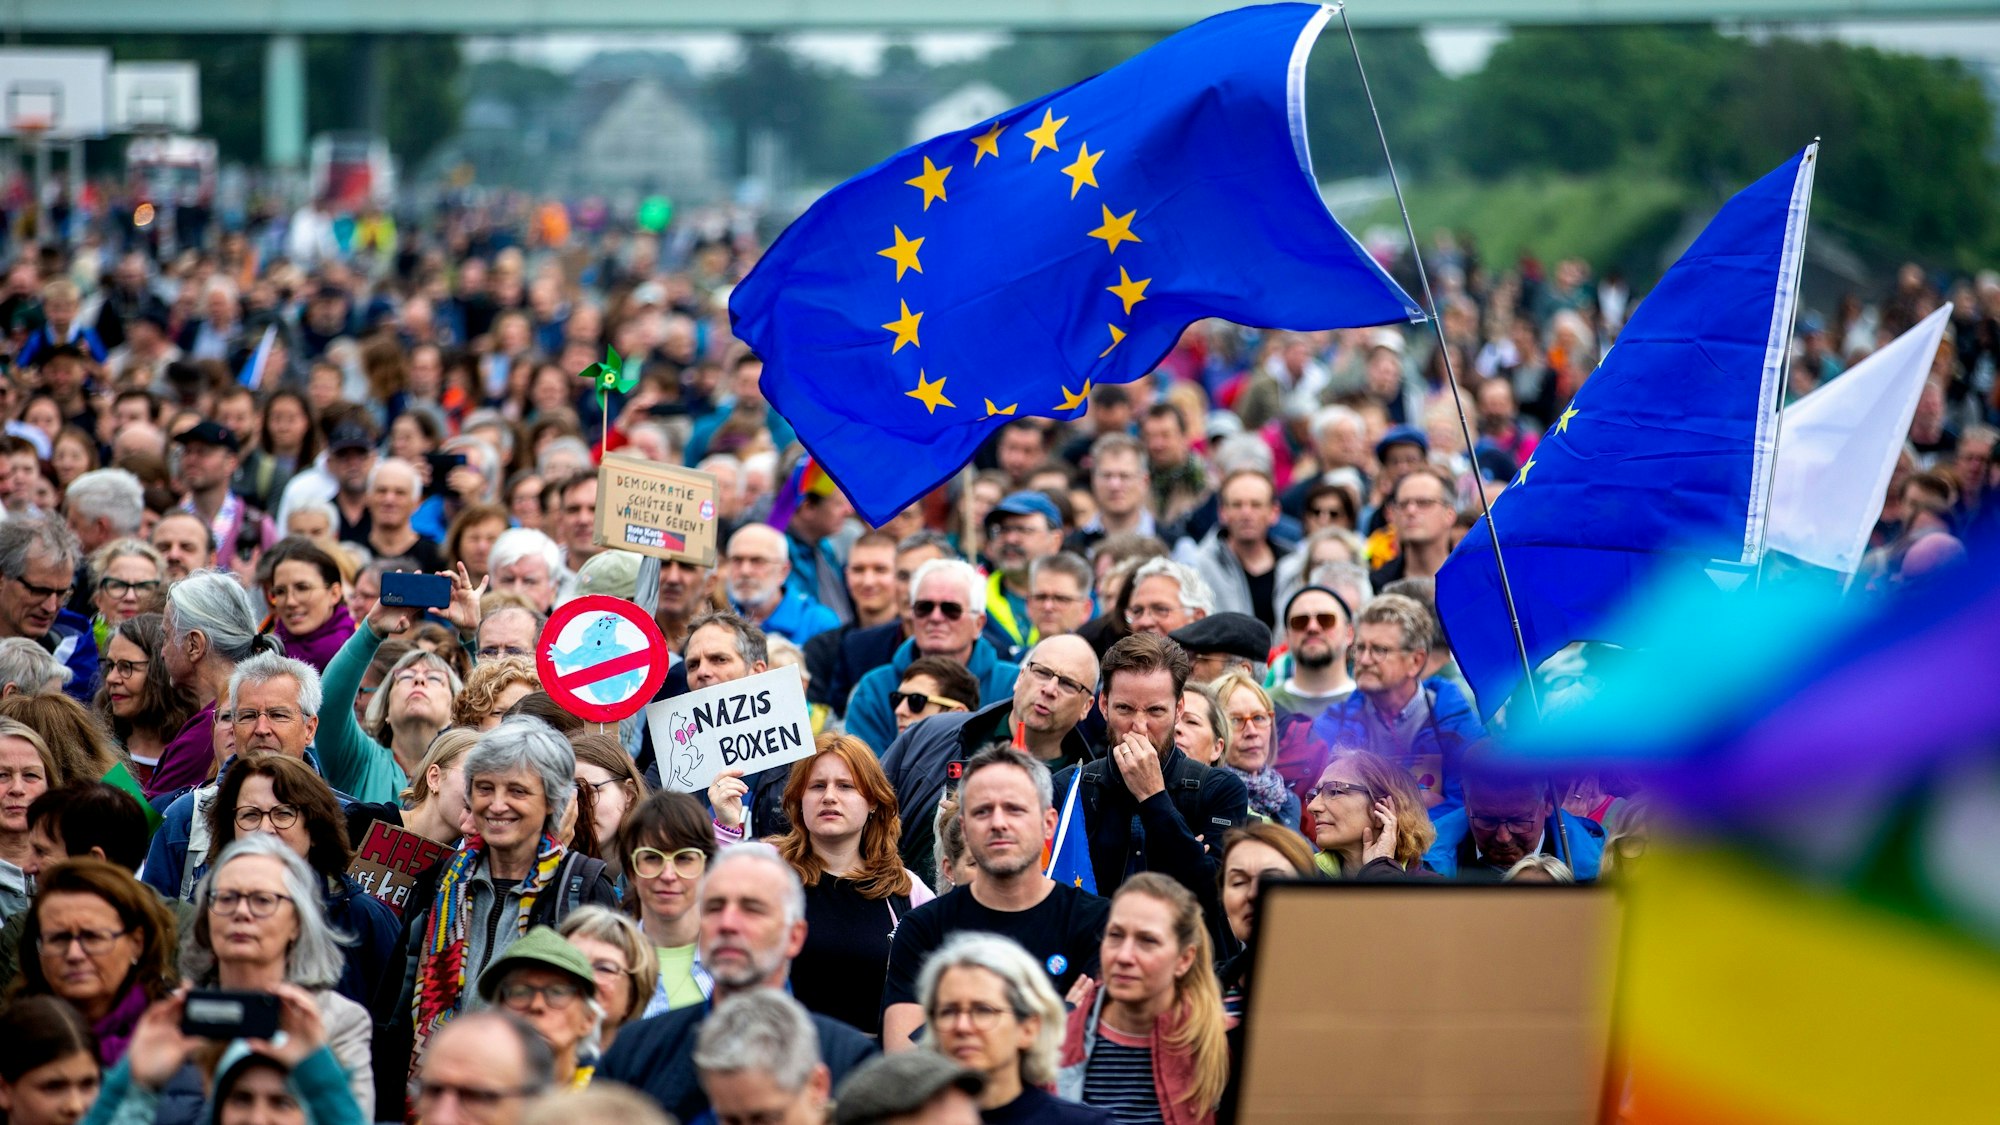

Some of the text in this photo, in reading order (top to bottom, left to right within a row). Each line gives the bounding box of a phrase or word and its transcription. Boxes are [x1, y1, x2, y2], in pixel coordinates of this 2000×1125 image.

[644, 528, 664, 538] Karte
[692, 690, 771, 734] NAZIS
[718, 722, 802, 766] BOXEN
[360, 822, 457, 877] HAS
